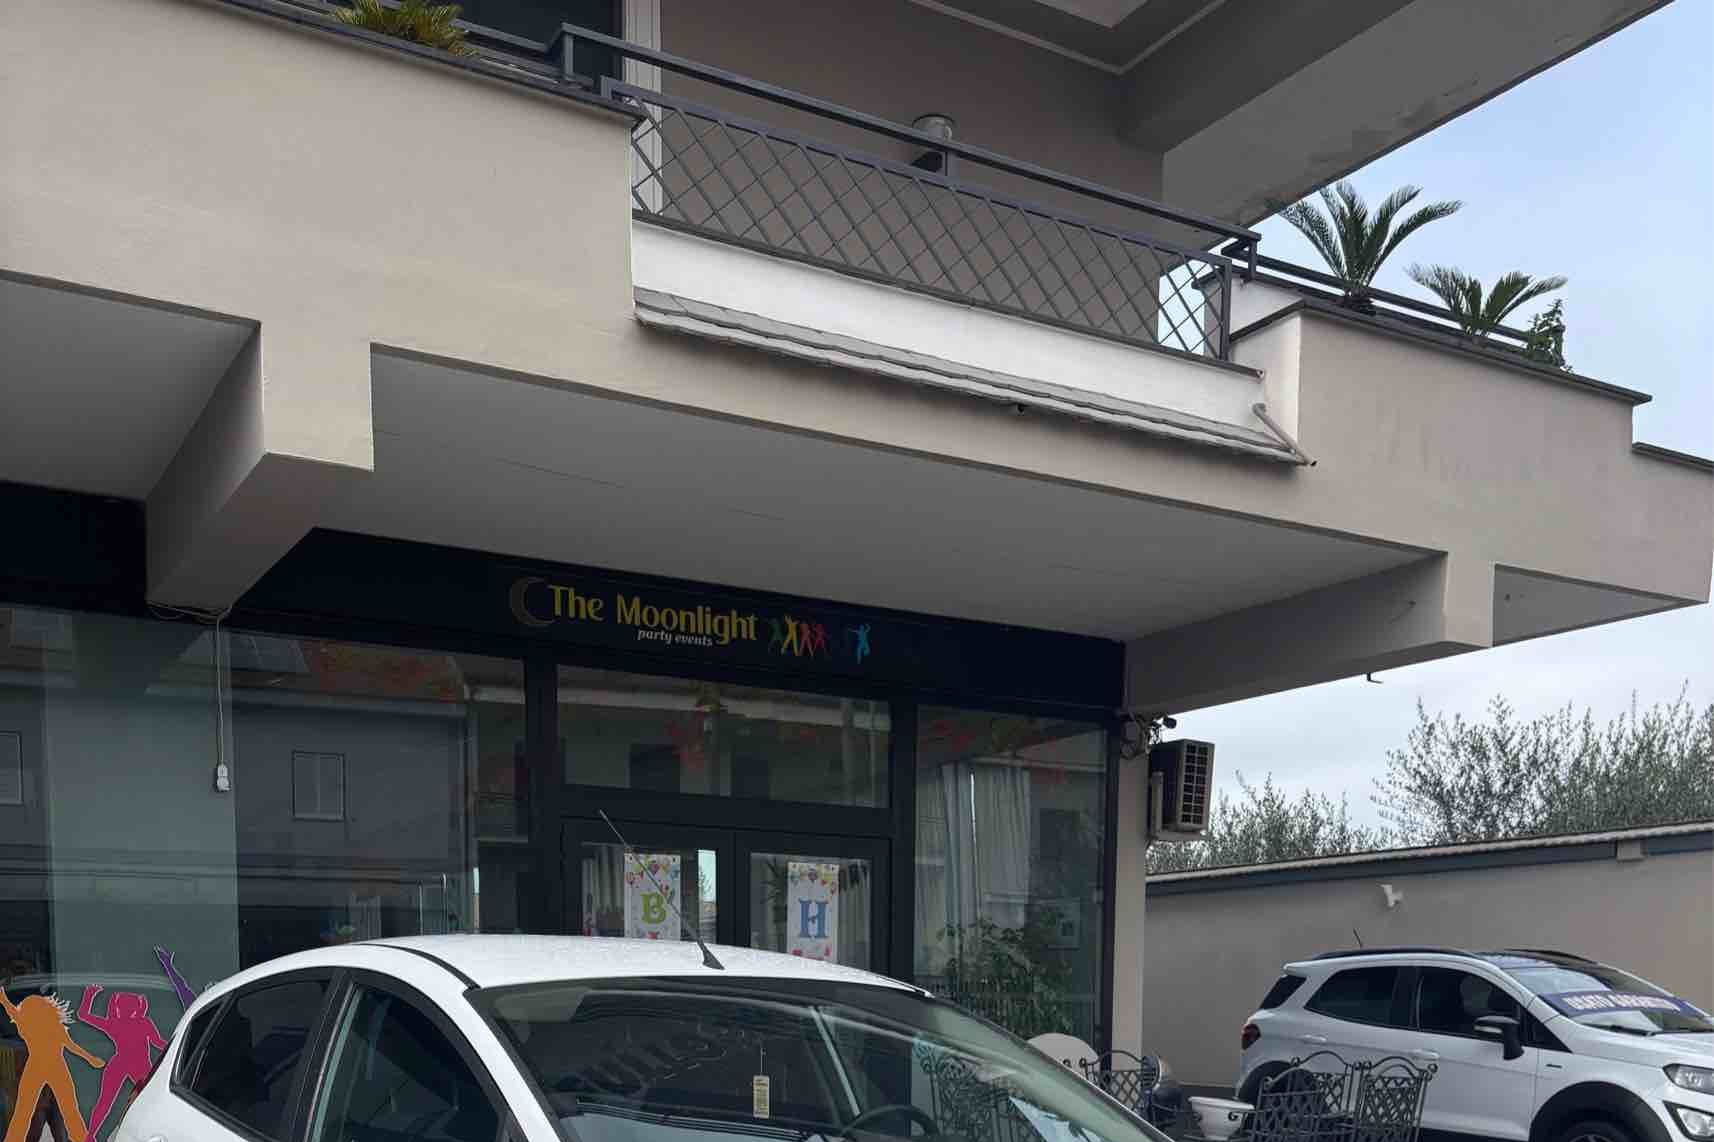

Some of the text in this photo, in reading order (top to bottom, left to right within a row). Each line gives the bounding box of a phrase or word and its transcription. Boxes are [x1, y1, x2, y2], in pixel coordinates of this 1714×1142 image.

[547, 584, 760, 645] The Moonlight
[637, 628, 714, 648] party events
[640, 892, 667, 925] B
[799, 900, 829, 939] H
